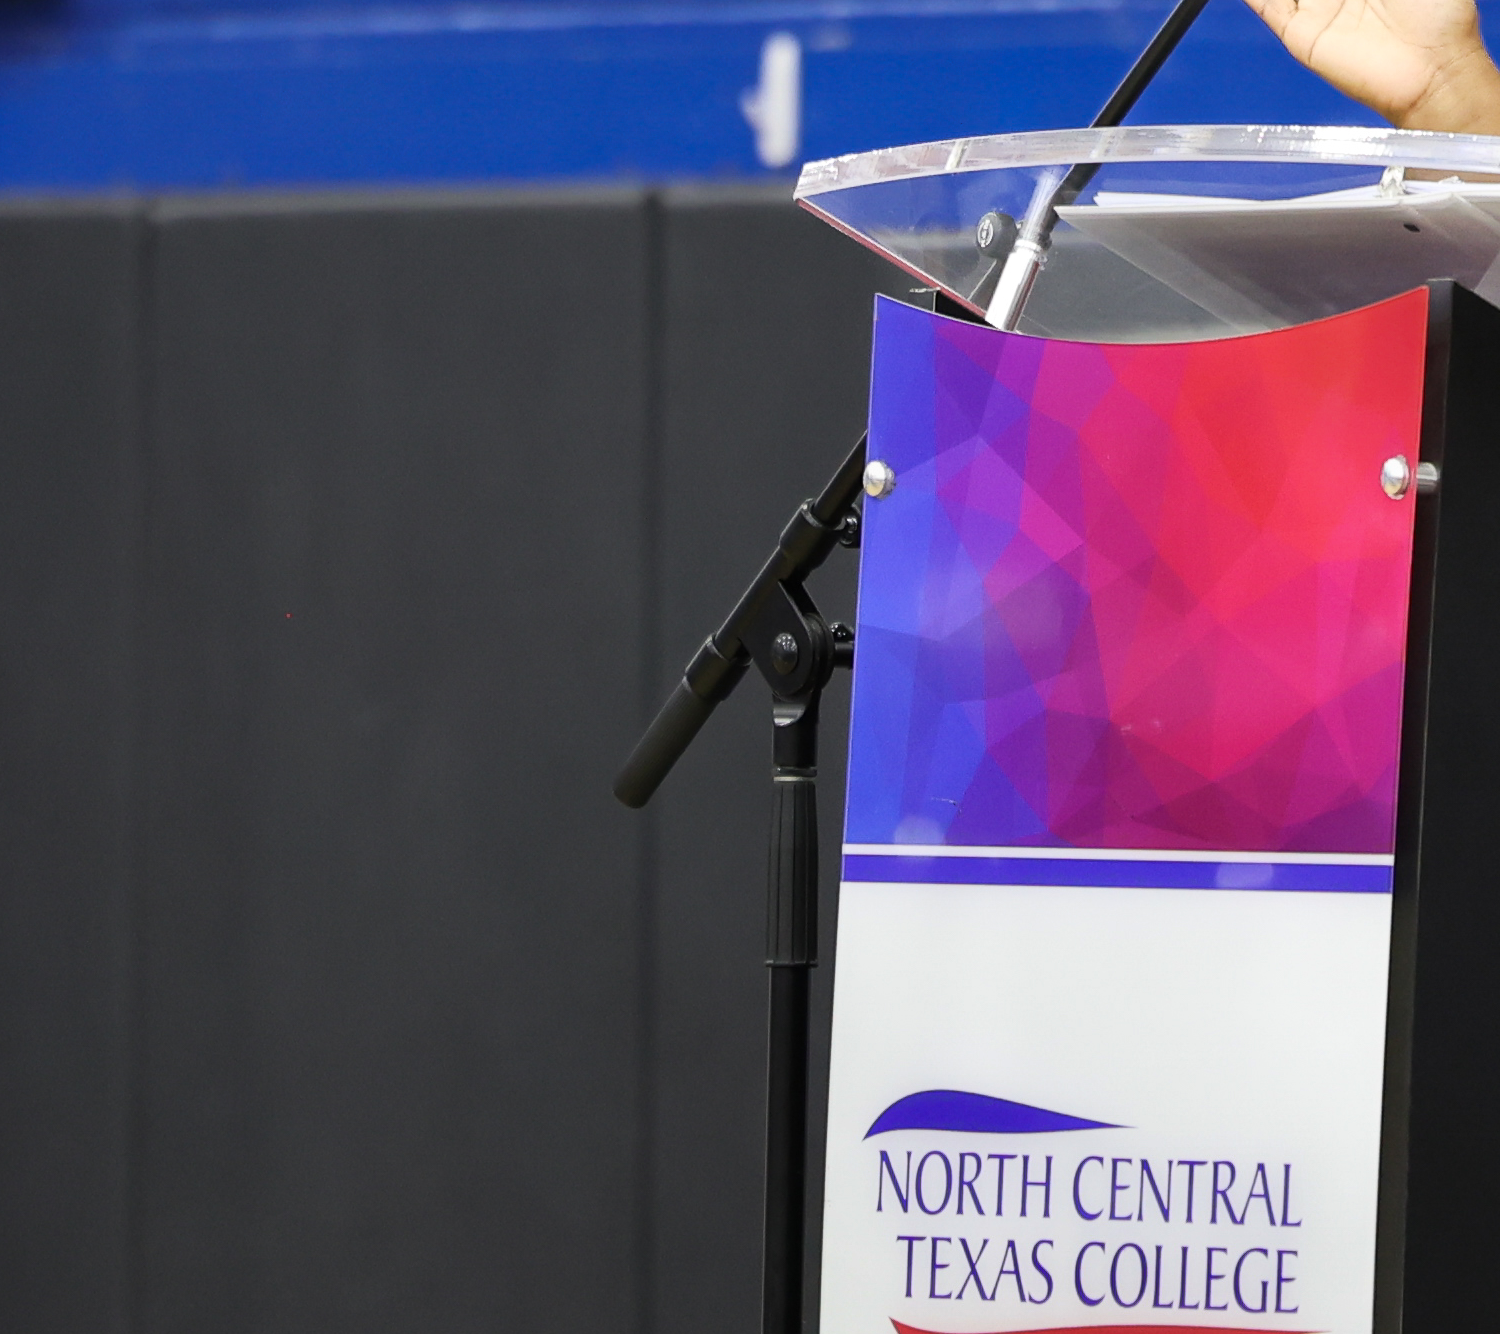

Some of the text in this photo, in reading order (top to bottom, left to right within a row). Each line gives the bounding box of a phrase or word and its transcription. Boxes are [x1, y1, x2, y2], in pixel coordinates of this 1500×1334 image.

[877, 1149, 1303, 1227] NORTH CENTRAL
[897, 1234, 1300, 1314] TEXAS COLLEGE
